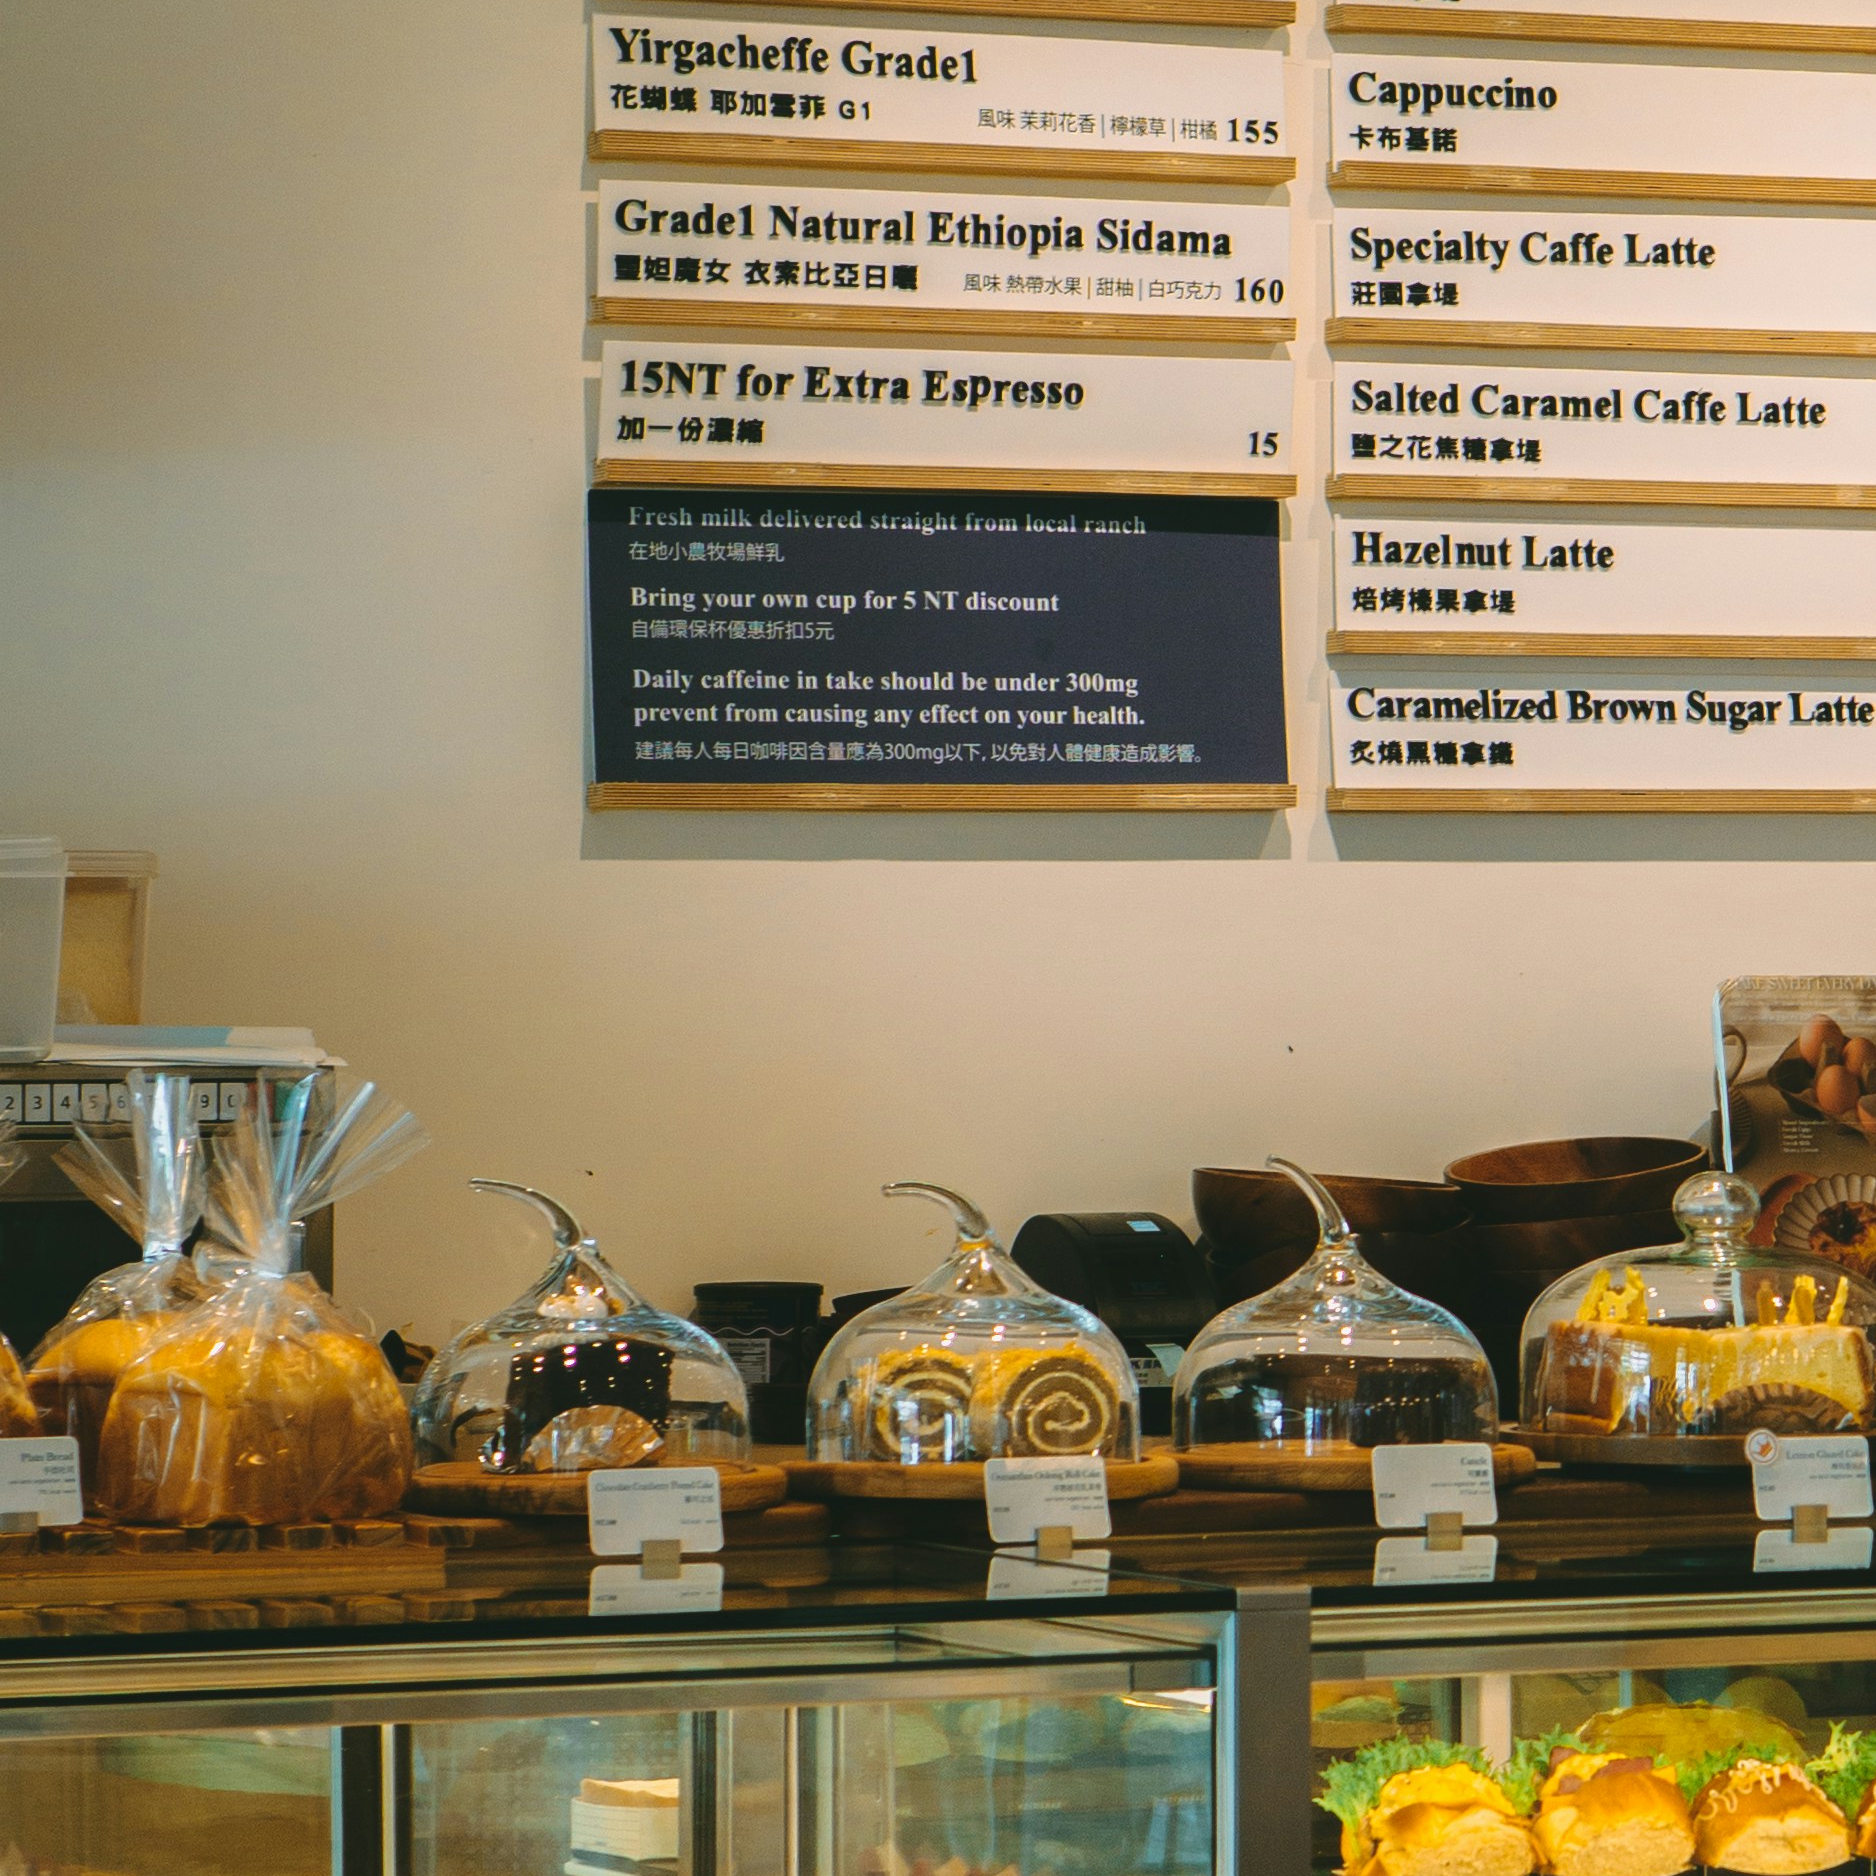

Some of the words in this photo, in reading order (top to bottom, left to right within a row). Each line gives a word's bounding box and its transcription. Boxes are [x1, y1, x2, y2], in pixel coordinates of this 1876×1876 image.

[609, 27, 829, 75] Yirgacheffe
[841, 40, 976, 83] Grade1
[1348, 71, 1558, 115] Cappuccino
[1229, 118, 1279, 145] 155
[1349, 125, 1457, 153] 卡布基諾
[614, 199, 753, 237] Grade1
[769, 205, 914, 243] Natural
[928, 211, 1084, 257] Ethiopia
[1096, 218, 1231, 256] Sidama
[1350, 227, 1509, 271] Specialty
[1520, 231, 1614, 266] Caffe
[1624, 233, 1715, 267] Latte
[1236, 277, 1284, 304] 160
[622, 360, 727, 396] 15NT
[737, 363, 795, 397] for
[803, 365, 910, 401] Extra
[923, 369, 1084, 408] Espresso
[1352, 380, 1459, 415] Salted
[1471, 384, 1622, 420] Caramel
[1633, 389, 1726, 423] Caffe
[1737, 392, 1826, 426] Latte
[1250, 431, 1278, 457] 15
[1352, 531, 1511, 568] Hazelnut
[1523, 535, 1614, 570] Latte
[631, 586, 696, 612] Bring
[702, 593, 756, 612] your
[762, 594, 808, 608] own
[816, 594, 857, 614] cup
[864, 589, 897, 610] for
[903, 590, 917, 610] 5
[924, 590, 959, 610] NT
[965, 591, 1059, 612] discount
[633, 668, 691, 694] Daily
[700, 669, 790, 690] caffeine
[797, 670, 818, 690] in
[826, 670, 874, 690] take
[880, 671, 954, 691] should
[961, 671, 988, 691] be
[994, 672, 1060, 692] under
[1066, 672, 1139, 698] 300mg
[634, 705, 718, 727] prevent
[725, 702, 778, 723] from
[784, 703, 868, 728] causing
[874, 709, 910, 729] any
[919, 704, 978, 724] effect
[984, 710, 1011, 724] on
[1017, 710, 1068, 729] your
[1073, 705, 1145, 725] health.
[1347, 686, 1558, 721] Caramelized
[1566, 689, 1677, 722] Brown
[1686, 689, 1782, 732] Sugar
[1788, 692, 1875, 724] Latte
